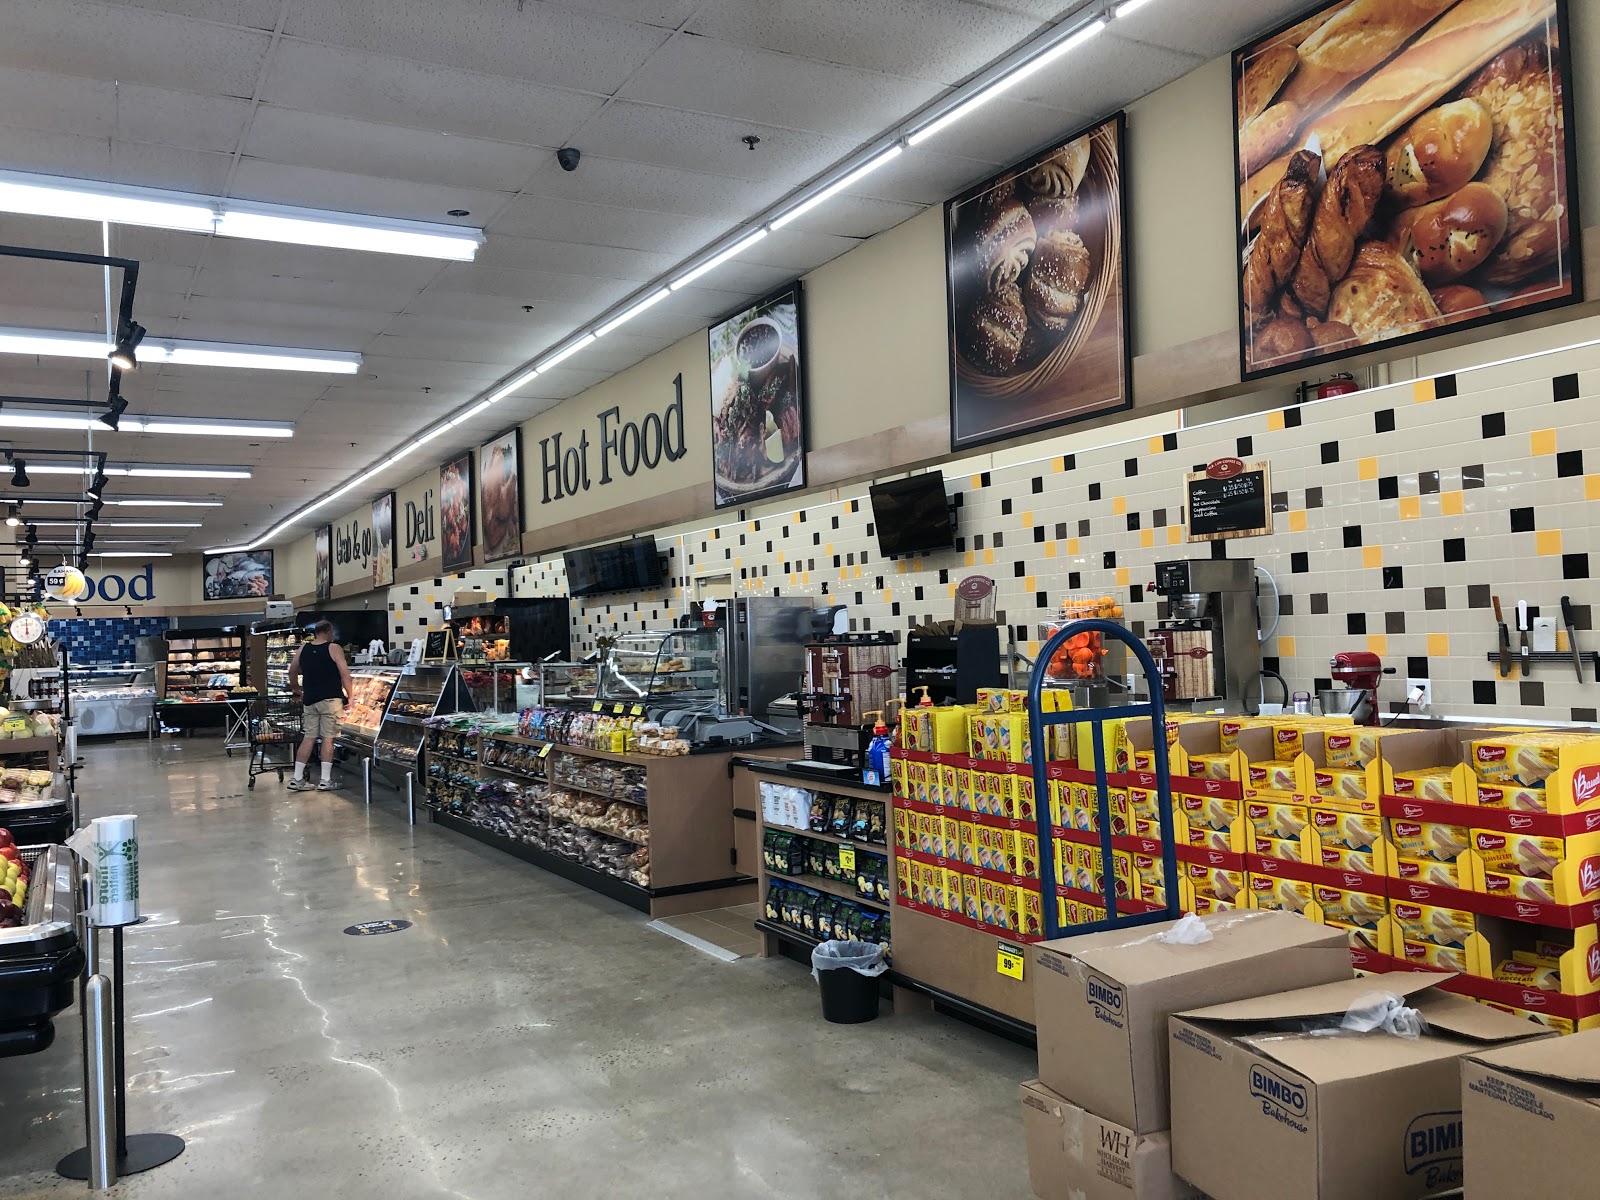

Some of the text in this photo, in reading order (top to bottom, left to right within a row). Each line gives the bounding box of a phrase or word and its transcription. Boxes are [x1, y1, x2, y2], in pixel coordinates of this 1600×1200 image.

[538, 372, 688, 504] Hot Food
[404, 488, 435, 548] Deli
[336, 519, 372, 569] Grab & go
[1088, 981, 1121, 1009] BIMBO
[1093, 1006, 1124, 1029] Bakehouse
[1252, 1071, 1304, 1109] BIMBO
[1486, 1075, 1536, 1100] KEEP FROZEN
[1261, 1100, 1308, 1134] Bakehouse
[1508, 1098, 1555, 1121] CONGELADO
[1100, 1124, 1131, 1159] WH
[1410, 1119, 1463, 1159] BIM
